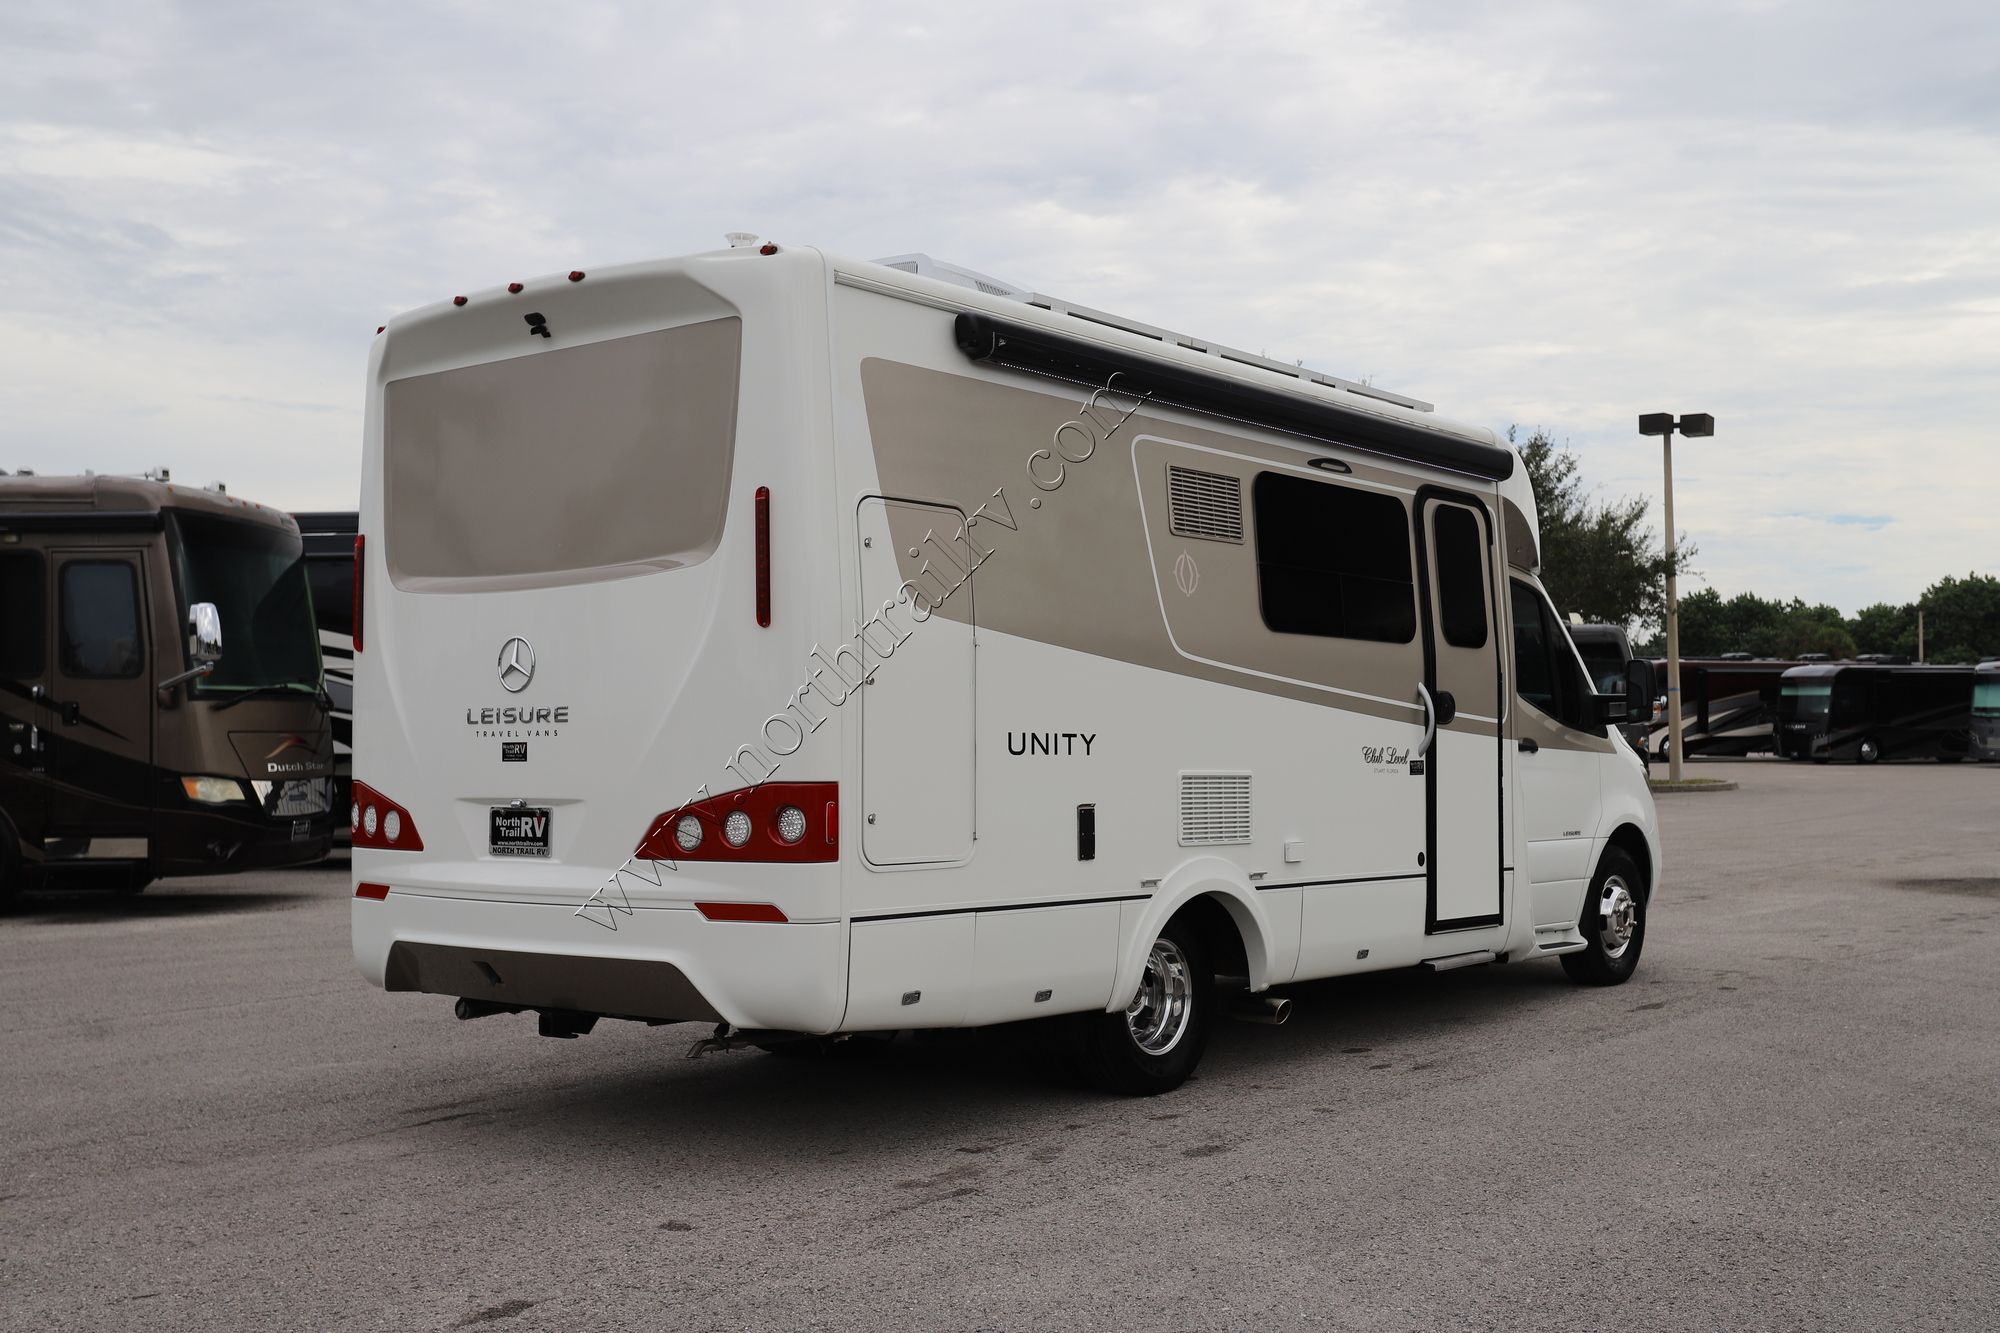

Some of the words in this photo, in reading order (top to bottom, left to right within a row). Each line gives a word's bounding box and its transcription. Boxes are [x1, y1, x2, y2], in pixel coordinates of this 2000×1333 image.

[466, 705, 569, 725] LEISURE
[475, 730, 519, 738] TRAVEL
[527, 729, 559, 737] VANS
[514, 743, 526, 754] RV
[1007, 732, 1097, 756] UNITY
[1361, 745, 1384, 764] Club
[1386, 746, 1410, 764] Level
[267, 761, 304, 773] Dutch
[305, 760, 325, 770] Star
[496, 816, 520, 826] North
[520, 816, 546, 838] RV
[499, 827, 520, 838] Trail
[492, 846, 515, 854] NORTH
[516, 847, 535, 855] TRAIL
[536, 848, 547, 856] RV
